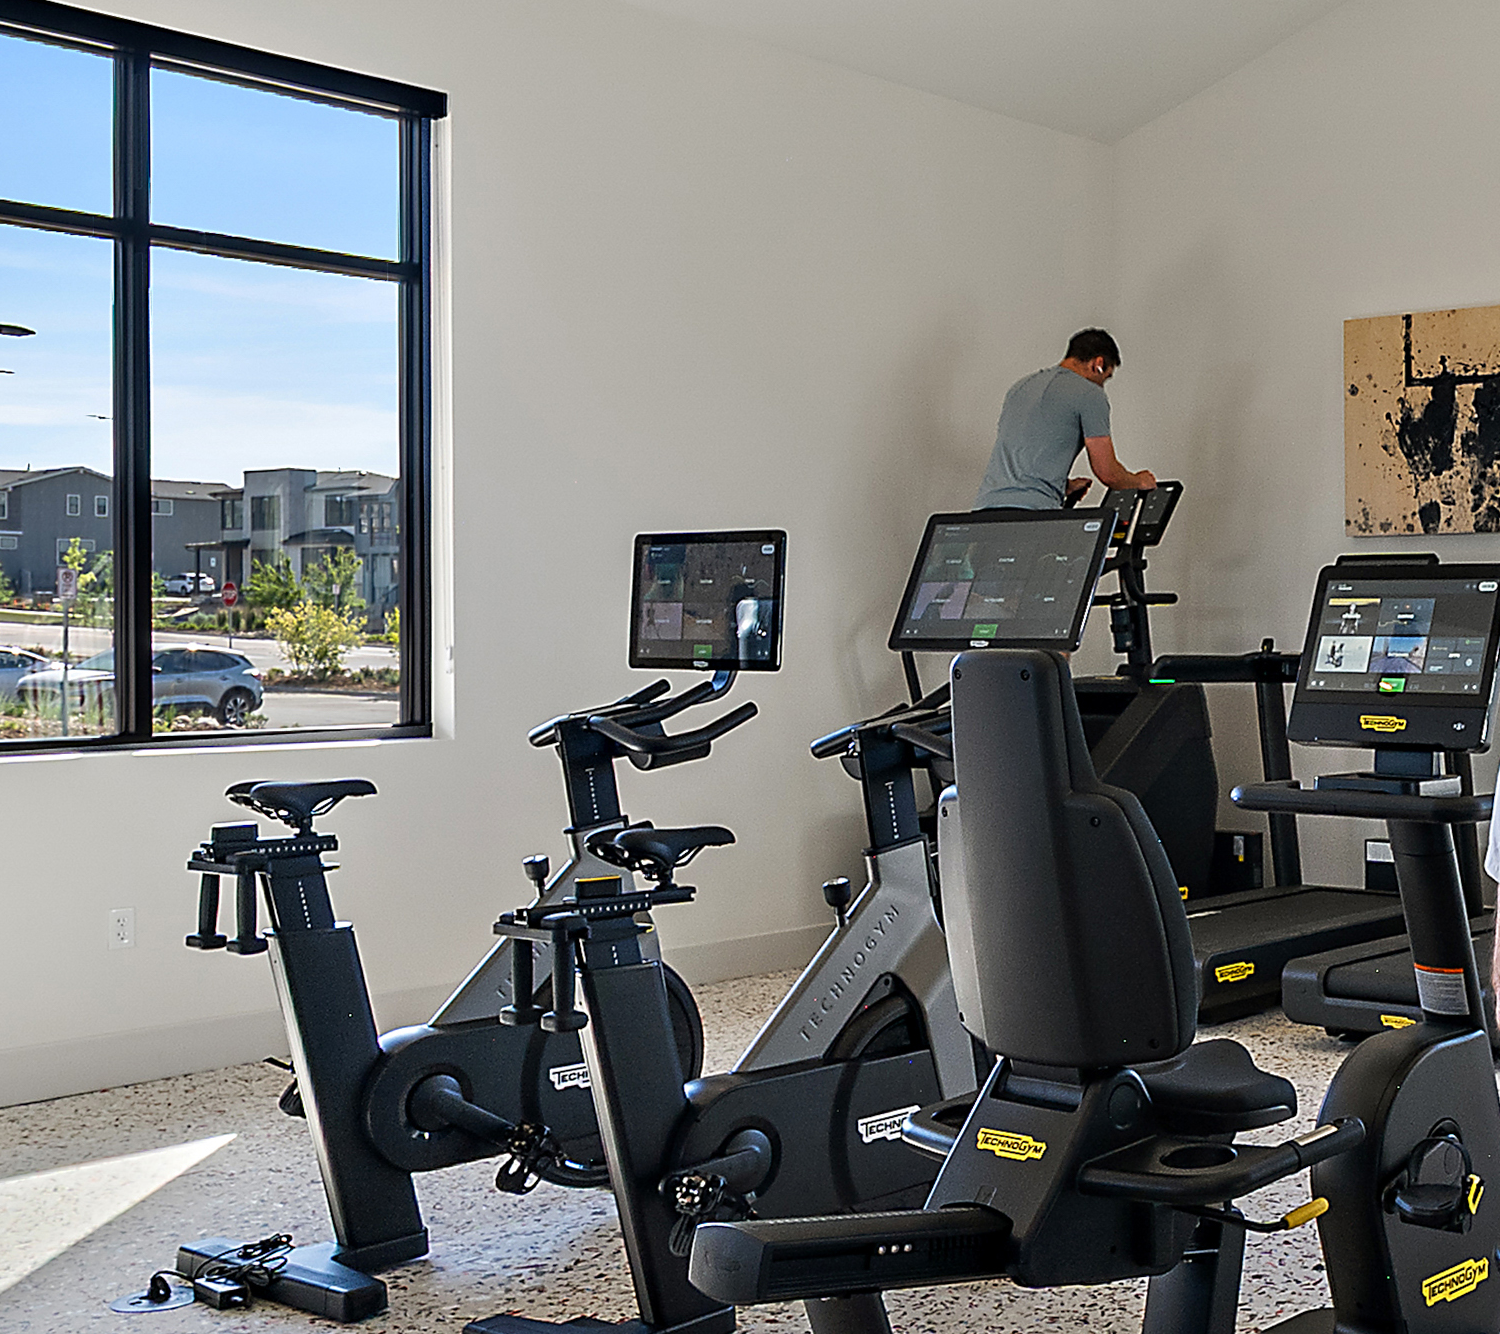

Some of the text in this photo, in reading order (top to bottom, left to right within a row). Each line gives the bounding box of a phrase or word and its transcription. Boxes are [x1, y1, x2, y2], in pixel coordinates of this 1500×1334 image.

[798, 903, 901, 1042] TECHNOGYM
[981, 1131, 1043, 1156] TECHNOGYM
[1424, 1263, 1486, 1300] TECHNOGYM
